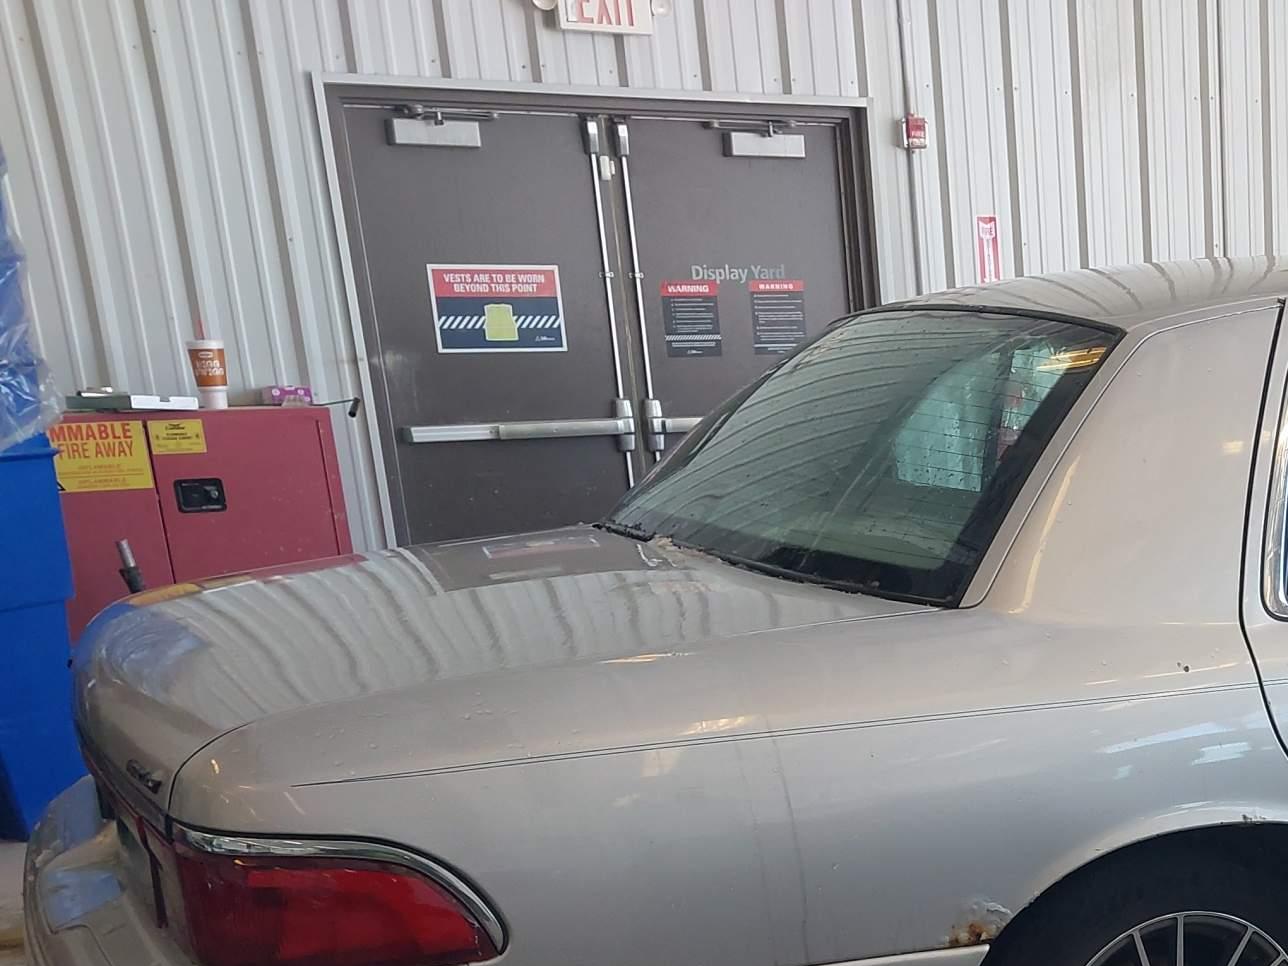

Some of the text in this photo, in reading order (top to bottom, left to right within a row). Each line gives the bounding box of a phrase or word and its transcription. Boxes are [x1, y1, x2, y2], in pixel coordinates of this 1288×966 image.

[443, 273, 545, 283] VESTS ARE TO BE WORN
[691, 264, 785, 283] Display Yard
[454, 283, 537, 293] BEYOND THIS POINT
[667, 284, 709, 293] WARNING
[58, 440, 134, 460] FIRE AWAY
